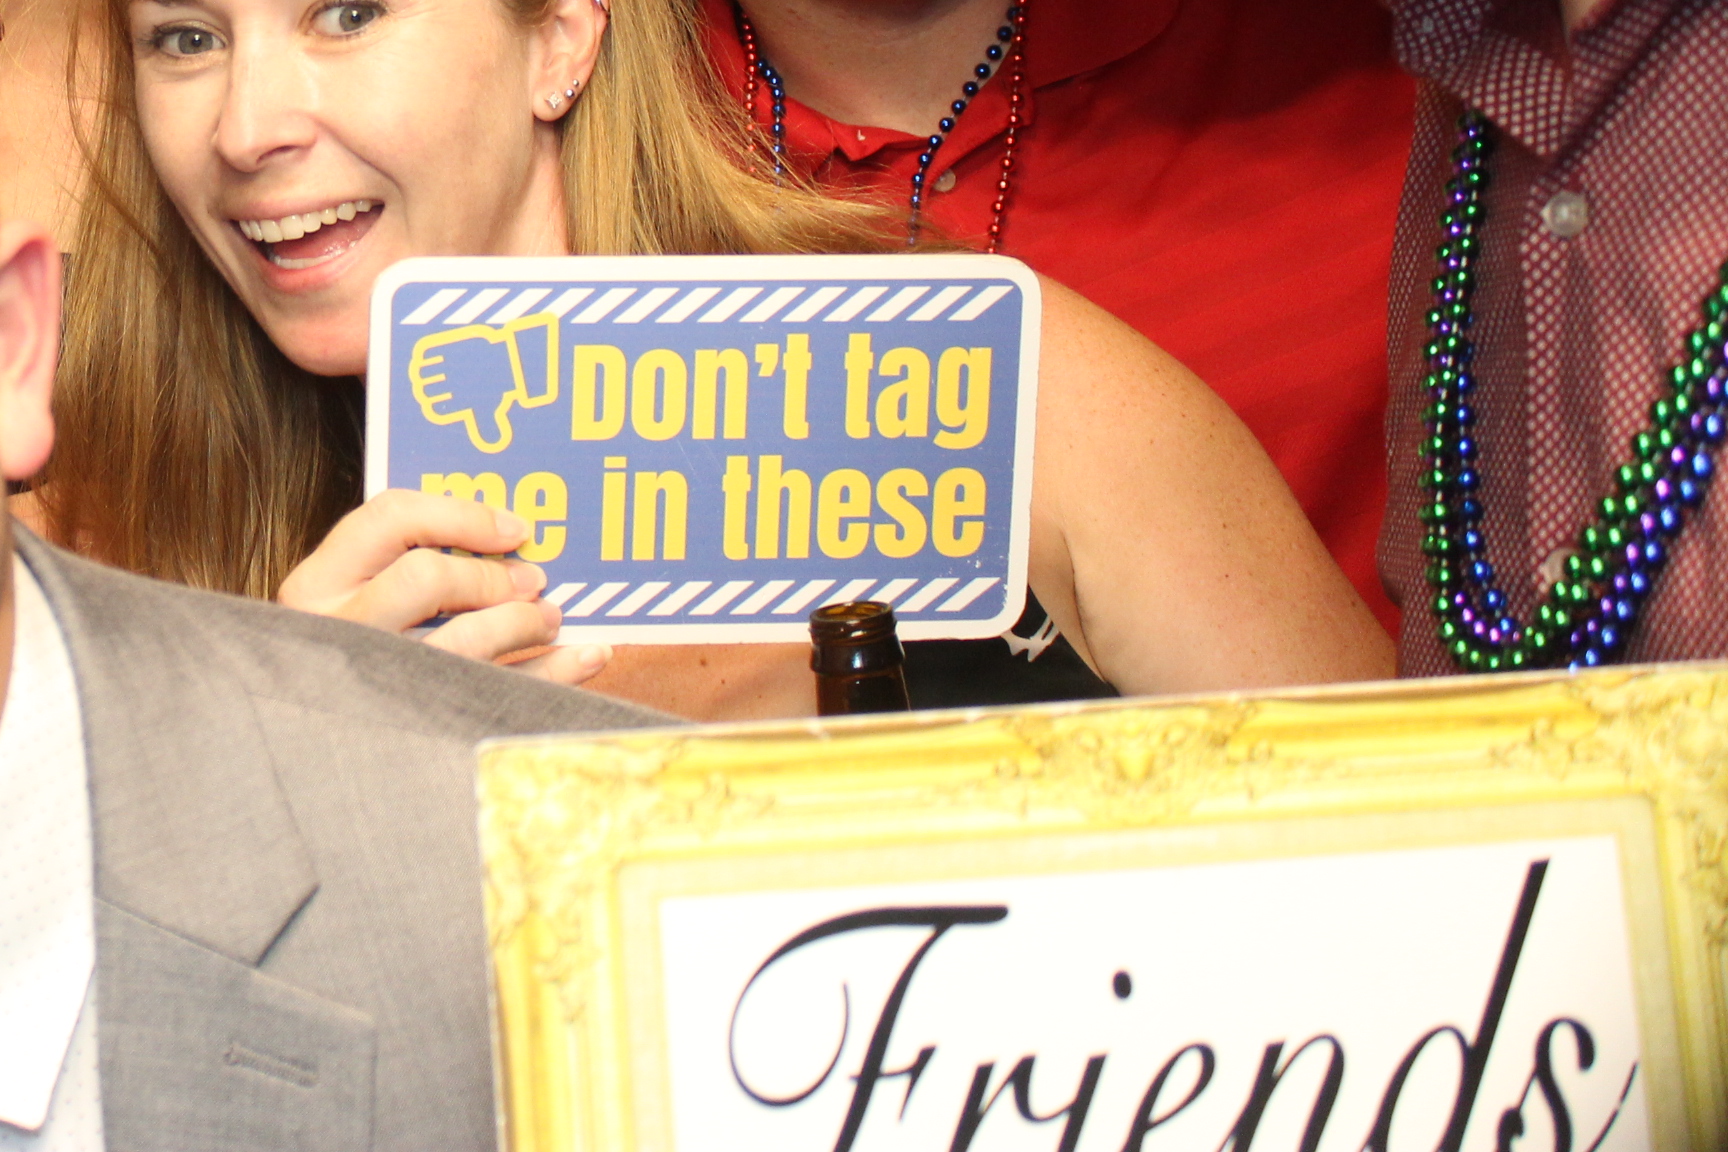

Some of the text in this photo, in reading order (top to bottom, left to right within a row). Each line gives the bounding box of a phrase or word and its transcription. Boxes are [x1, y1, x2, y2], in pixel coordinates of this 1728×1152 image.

[571, 332, 993, 450] Don't tag
[600, 455, 689, 561] in
[721, 454, 988, 560] these
[728, 857, 1640, 1152] Friends
